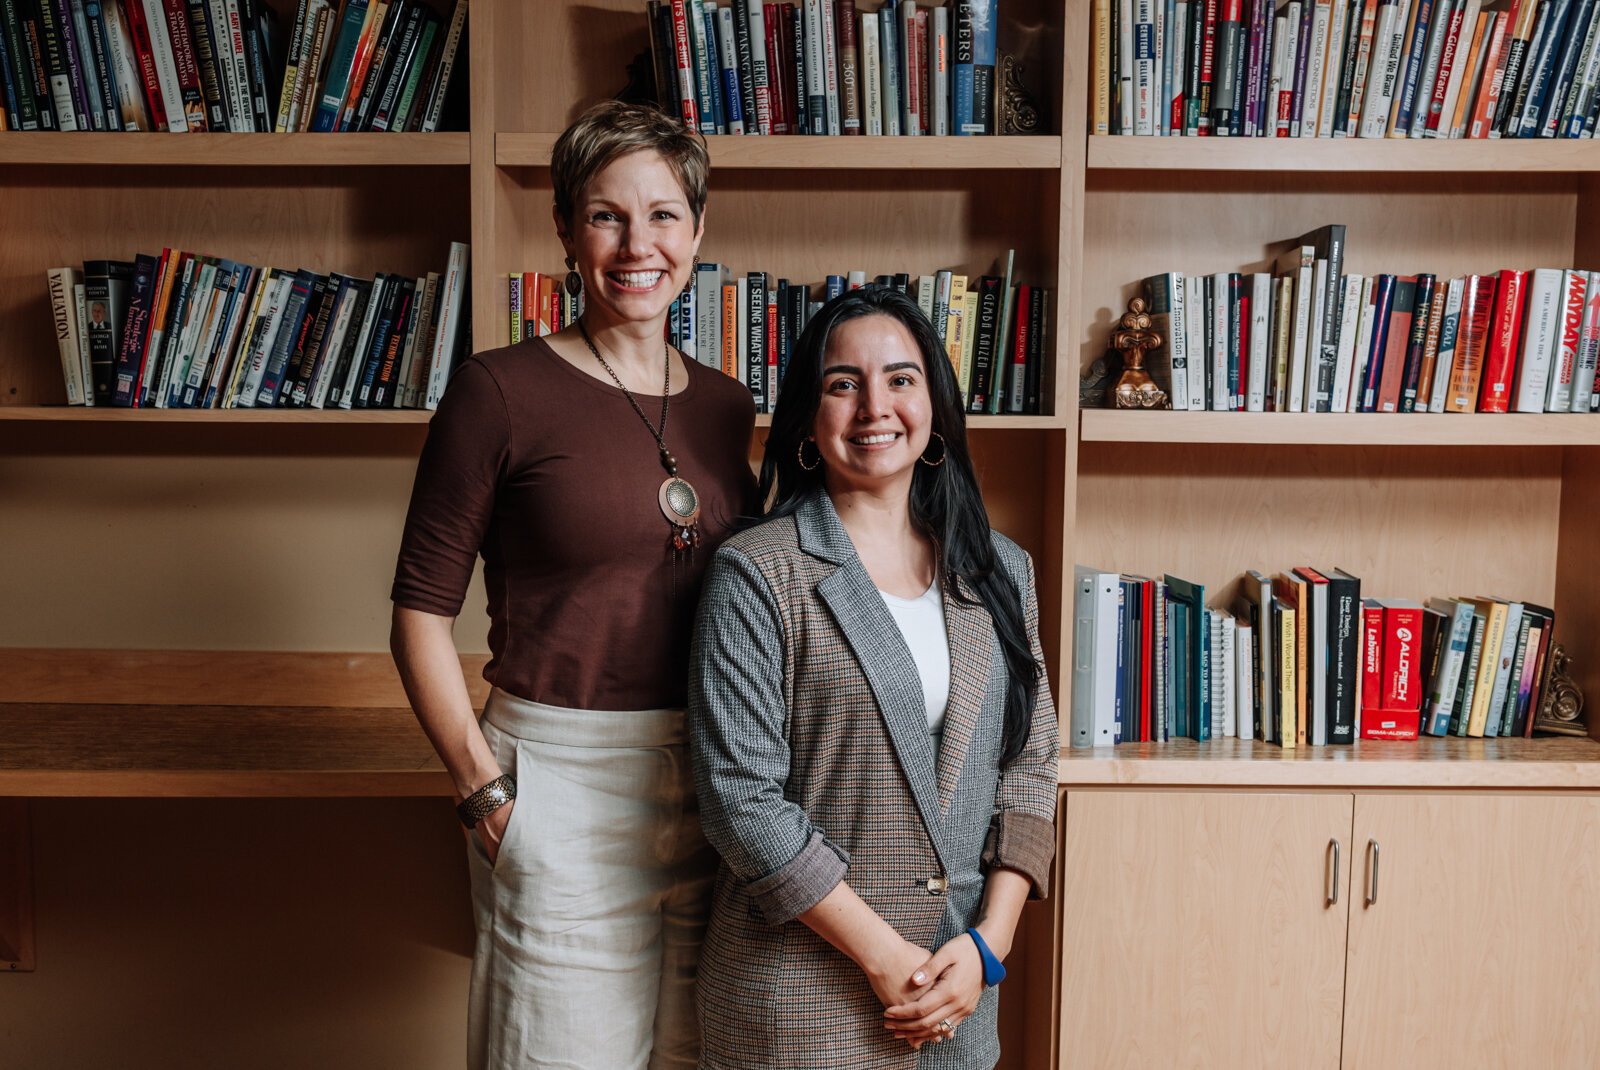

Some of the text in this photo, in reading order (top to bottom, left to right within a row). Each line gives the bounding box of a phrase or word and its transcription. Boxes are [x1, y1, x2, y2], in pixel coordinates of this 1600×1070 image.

[674, 0, 683, 17] IT'S
[46, 31, 62, 70] SAFARI
[169, 11, 189, 86] STRATEGY ANALYSIS
[177, 11, 195, 74] CONTEMPORARY
[230, 12, 248, 97] GARY HAMEL LEADING THE
[290, 24, 303, 62] Workbook
[676, 20, 686, 44] YOUR
[958, 3, 972, 61] ETERS
[91, 20, 113, 107] REDEFINING GLOBAL STRATEGY
[142, 53, 158, 91] STRATEGY
[739, 29, 754, 116] TAKING ADVICE
[754, 60, 766, 86] BENCH
[1139, 25, 1148, 87] CENTERED SELLING
[1308, 20, 1325, 110] CUSTOMER CONNECTIONS
[1382, 33, 1402, 98] United We Brand
[1403, 28, 1425, 112] BUILDING STRONG BRANDS
[1434, 13, 1462, 99] The Global Brand
[1501, 41, 1525, 93] SATISFACTION
[228, 75, 236, 97] LONG
[437, 80, 446, 102] LONG
[796, 62, 804, 110] LEADERSHIP
[1565, 75, 1583, 117] BLUNDERS
[432, 105, 440, 124] VIEW
[47, 274, 73, 341] VALUATION
[415, 279, 436, 354] The Living Organization
[510, 280, 519, 312] board
[1501, 280, 1517, 348] LOOKING SUN
[1543, 292, 1551, 305] THE
[1561, 275, 1587, 355] MAYDAY
[119, 296, 141, 363] Management
[128, 309, 148, 354] Strategic
[262, 304, 279, 337] Teams
[407, 308, 418, 335] Building
[682, 308, 691, 341] DATA
[751, 288, 762, 390] SEEING WHAT'S NEXT
[977, 293, 995, 369] GEMBA KAIZEN
[1174, 308, 1183, 356] Innovation
[1425, 292, 1445, 359] GETTING LEAN
[1443, 316, 1457, 349] GOAL
[1539, 308, 1549, 343] AMERICAN
[251, 350, 264, 372] TOP
[379, 334, 401, 383] TECHNO VISION
[1536, 344, 1544, 361] IDEA
[1224, 628, 1232, 654] blink
[1285, 643, 1293, 670] Worked
[1366, 628, 1377, 673] Labware
[1488, 622, 1500, 656] GEOGRAPHY
[1513, 619, 1531, 682] MILLION DOLLAR ARM
[1203, 669, 1209, 679] TO
[1396, 642, 1412, 702] ALDRICH
[1483, 665, 1492, 686] GENIUS
[1367, 729, 1415, 737] SIGMA-ALDRICH
